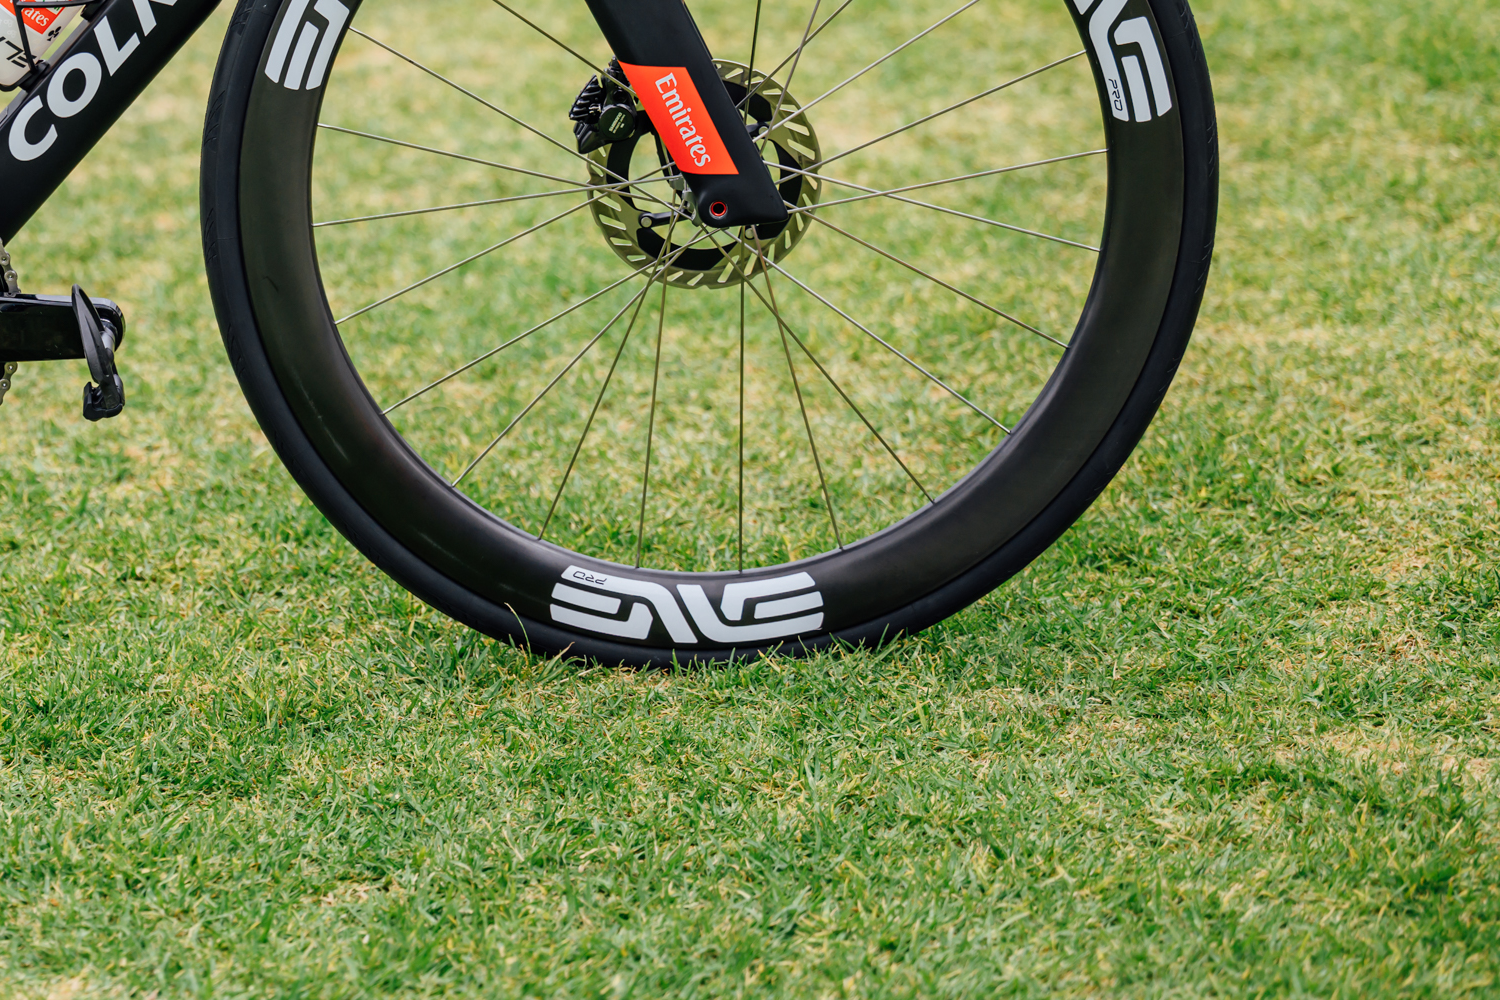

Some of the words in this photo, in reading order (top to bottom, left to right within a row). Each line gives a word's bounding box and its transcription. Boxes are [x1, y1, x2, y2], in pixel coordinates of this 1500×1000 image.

[1108, 78, 1123, 111] PRO
[654, 72, 711, 168] Emirates
[572, 570, 607, 586] PRO
